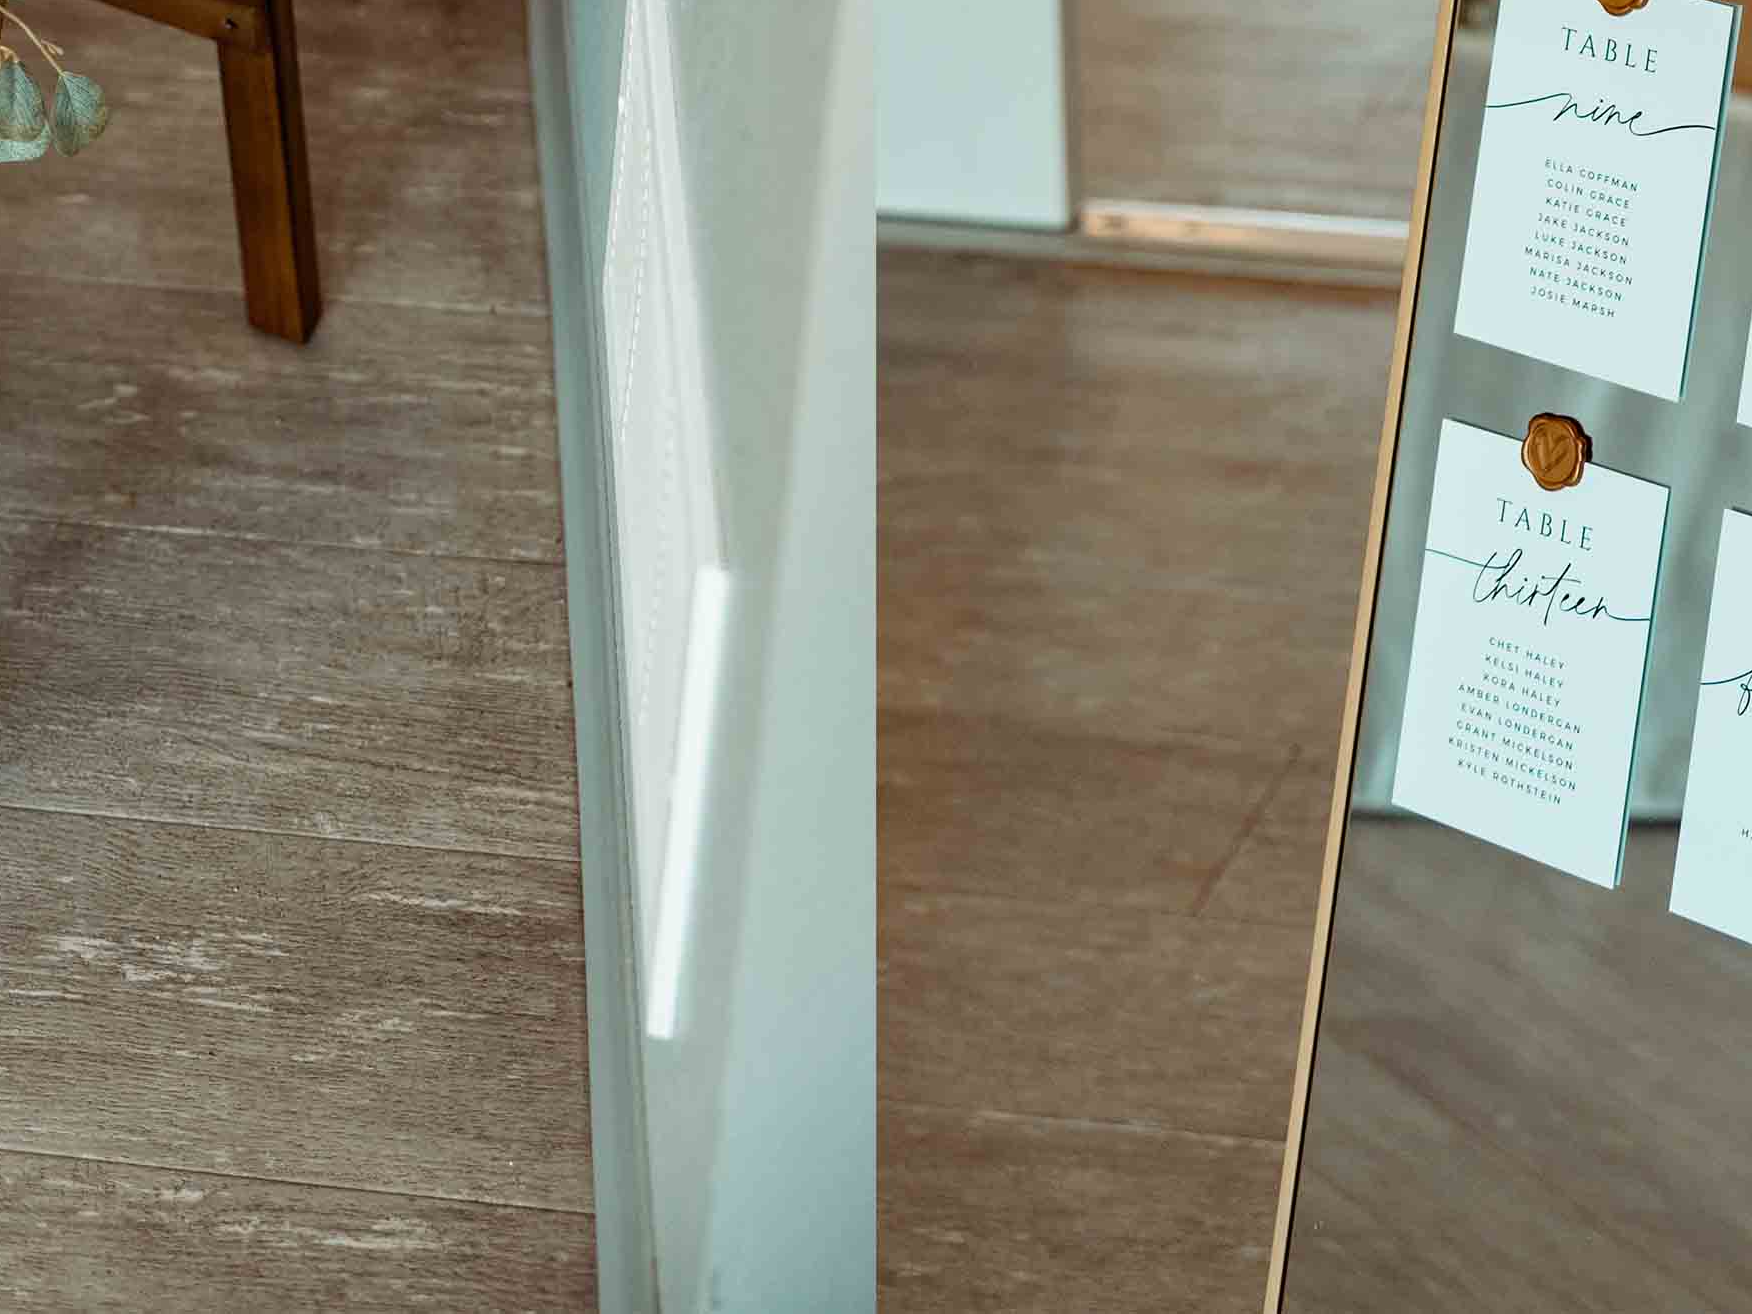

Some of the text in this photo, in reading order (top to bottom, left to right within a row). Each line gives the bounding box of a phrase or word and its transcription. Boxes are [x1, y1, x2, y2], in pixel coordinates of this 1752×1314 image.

[1562, 27, 1658, 73] TABLE
[1497, 498, 1593, 551] TABLE
[1471, 548, 1618, 625] thirteen
